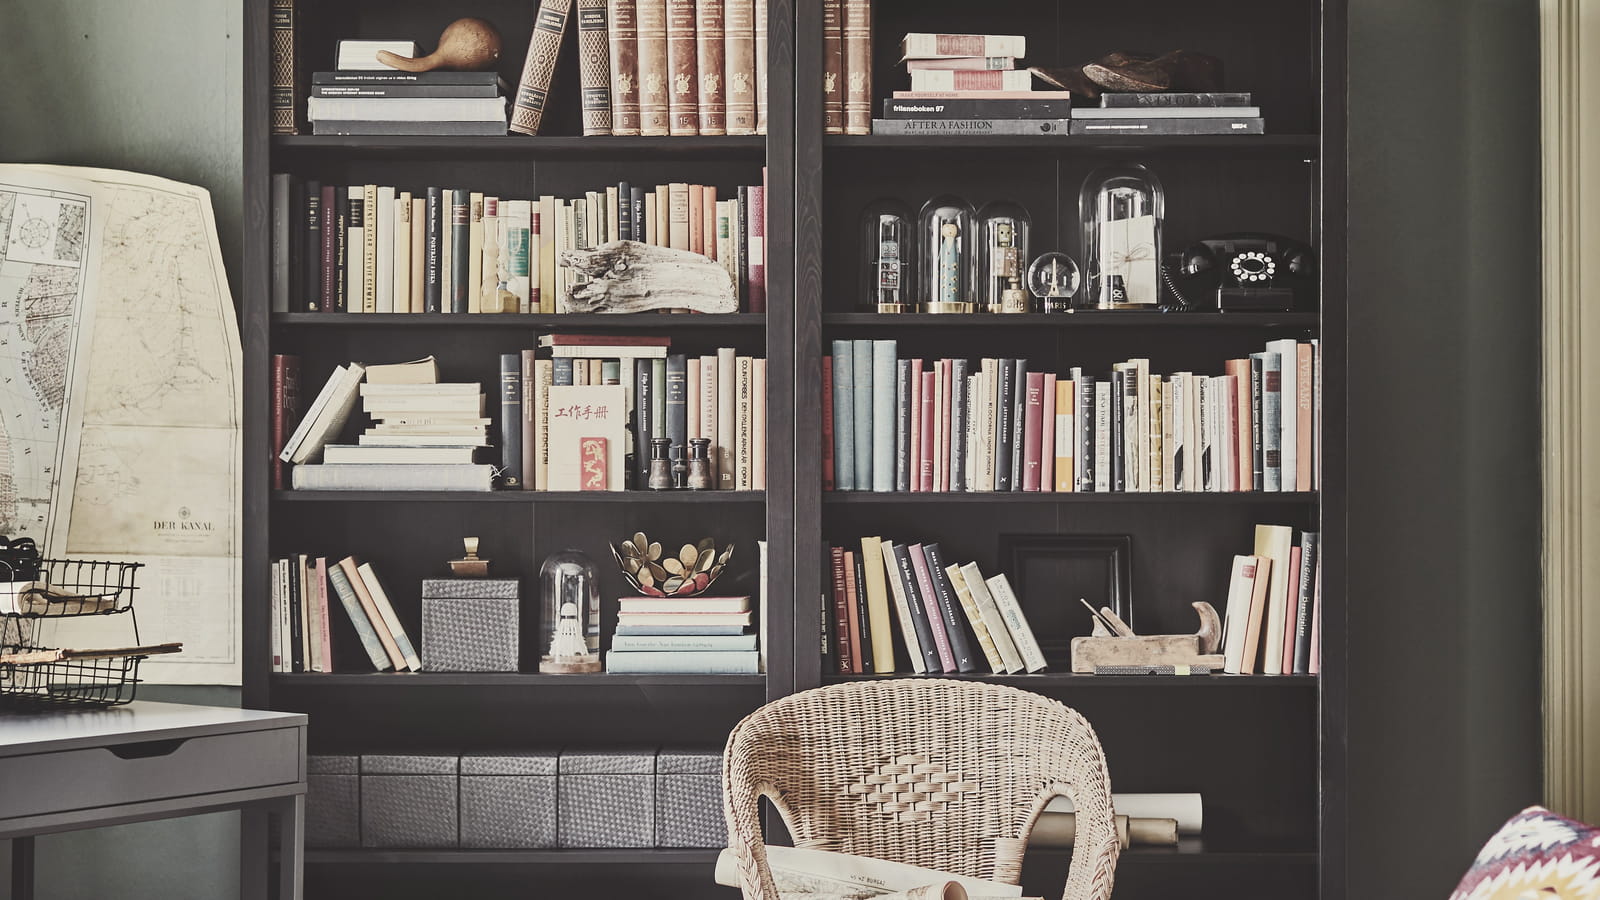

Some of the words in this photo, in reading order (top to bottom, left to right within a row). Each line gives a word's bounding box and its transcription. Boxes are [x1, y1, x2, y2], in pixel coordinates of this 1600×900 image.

[893, 105, 934, 113] frilansboken
[904, 121, 938, 129] AFTER
[939, 121, 946, 129] A
[949, 120, 993, 129] FASHION
[554, 404, 609, 421] 工作手册
[153, 520, 176, 530] DER
[181, 521, 215, 531] KANAL
